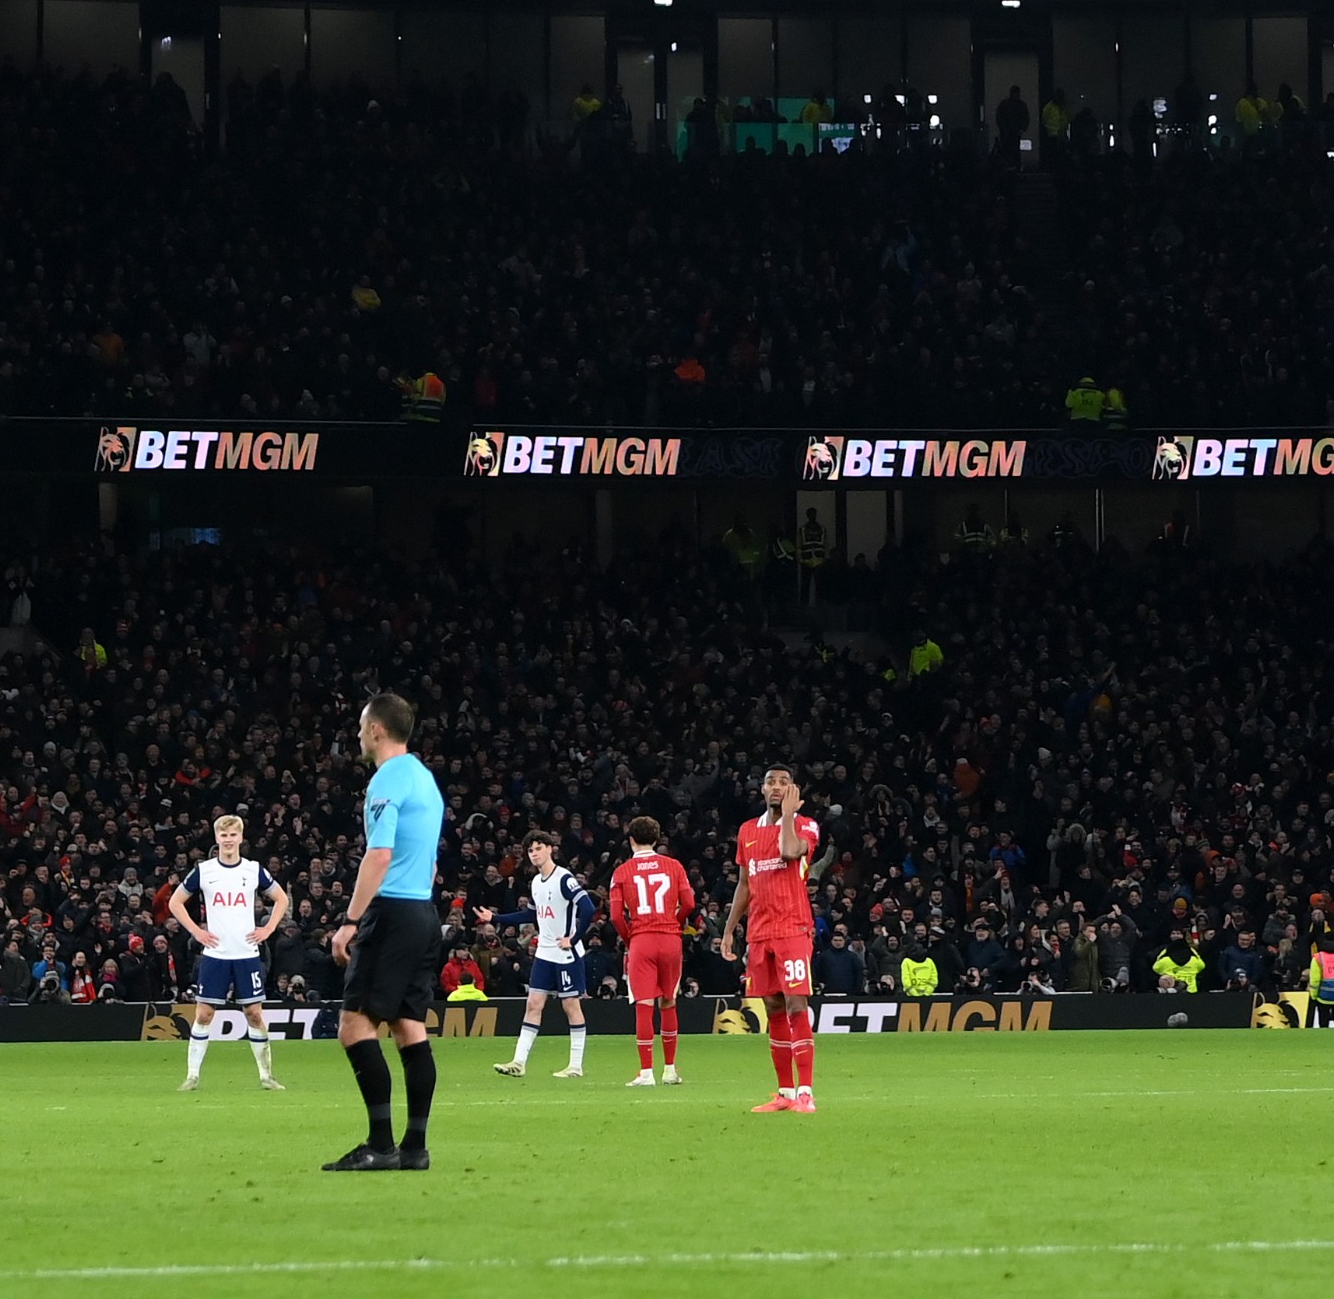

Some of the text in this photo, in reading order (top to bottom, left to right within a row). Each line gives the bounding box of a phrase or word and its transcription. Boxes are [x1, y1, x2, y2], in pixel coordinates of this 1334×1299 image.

[135, 431, 318, 470] BETMGM
[503, 436, 680, 475] BETMGM
[843, 440, 1026, 477] BETMGM
[212, 891, 246, 907] AIA
[633, 873, 671, 915] 17
[251, 972, 262, 989] 15
[561, 971, 571, 986] 14
[783, 959, 806, 982] 38
